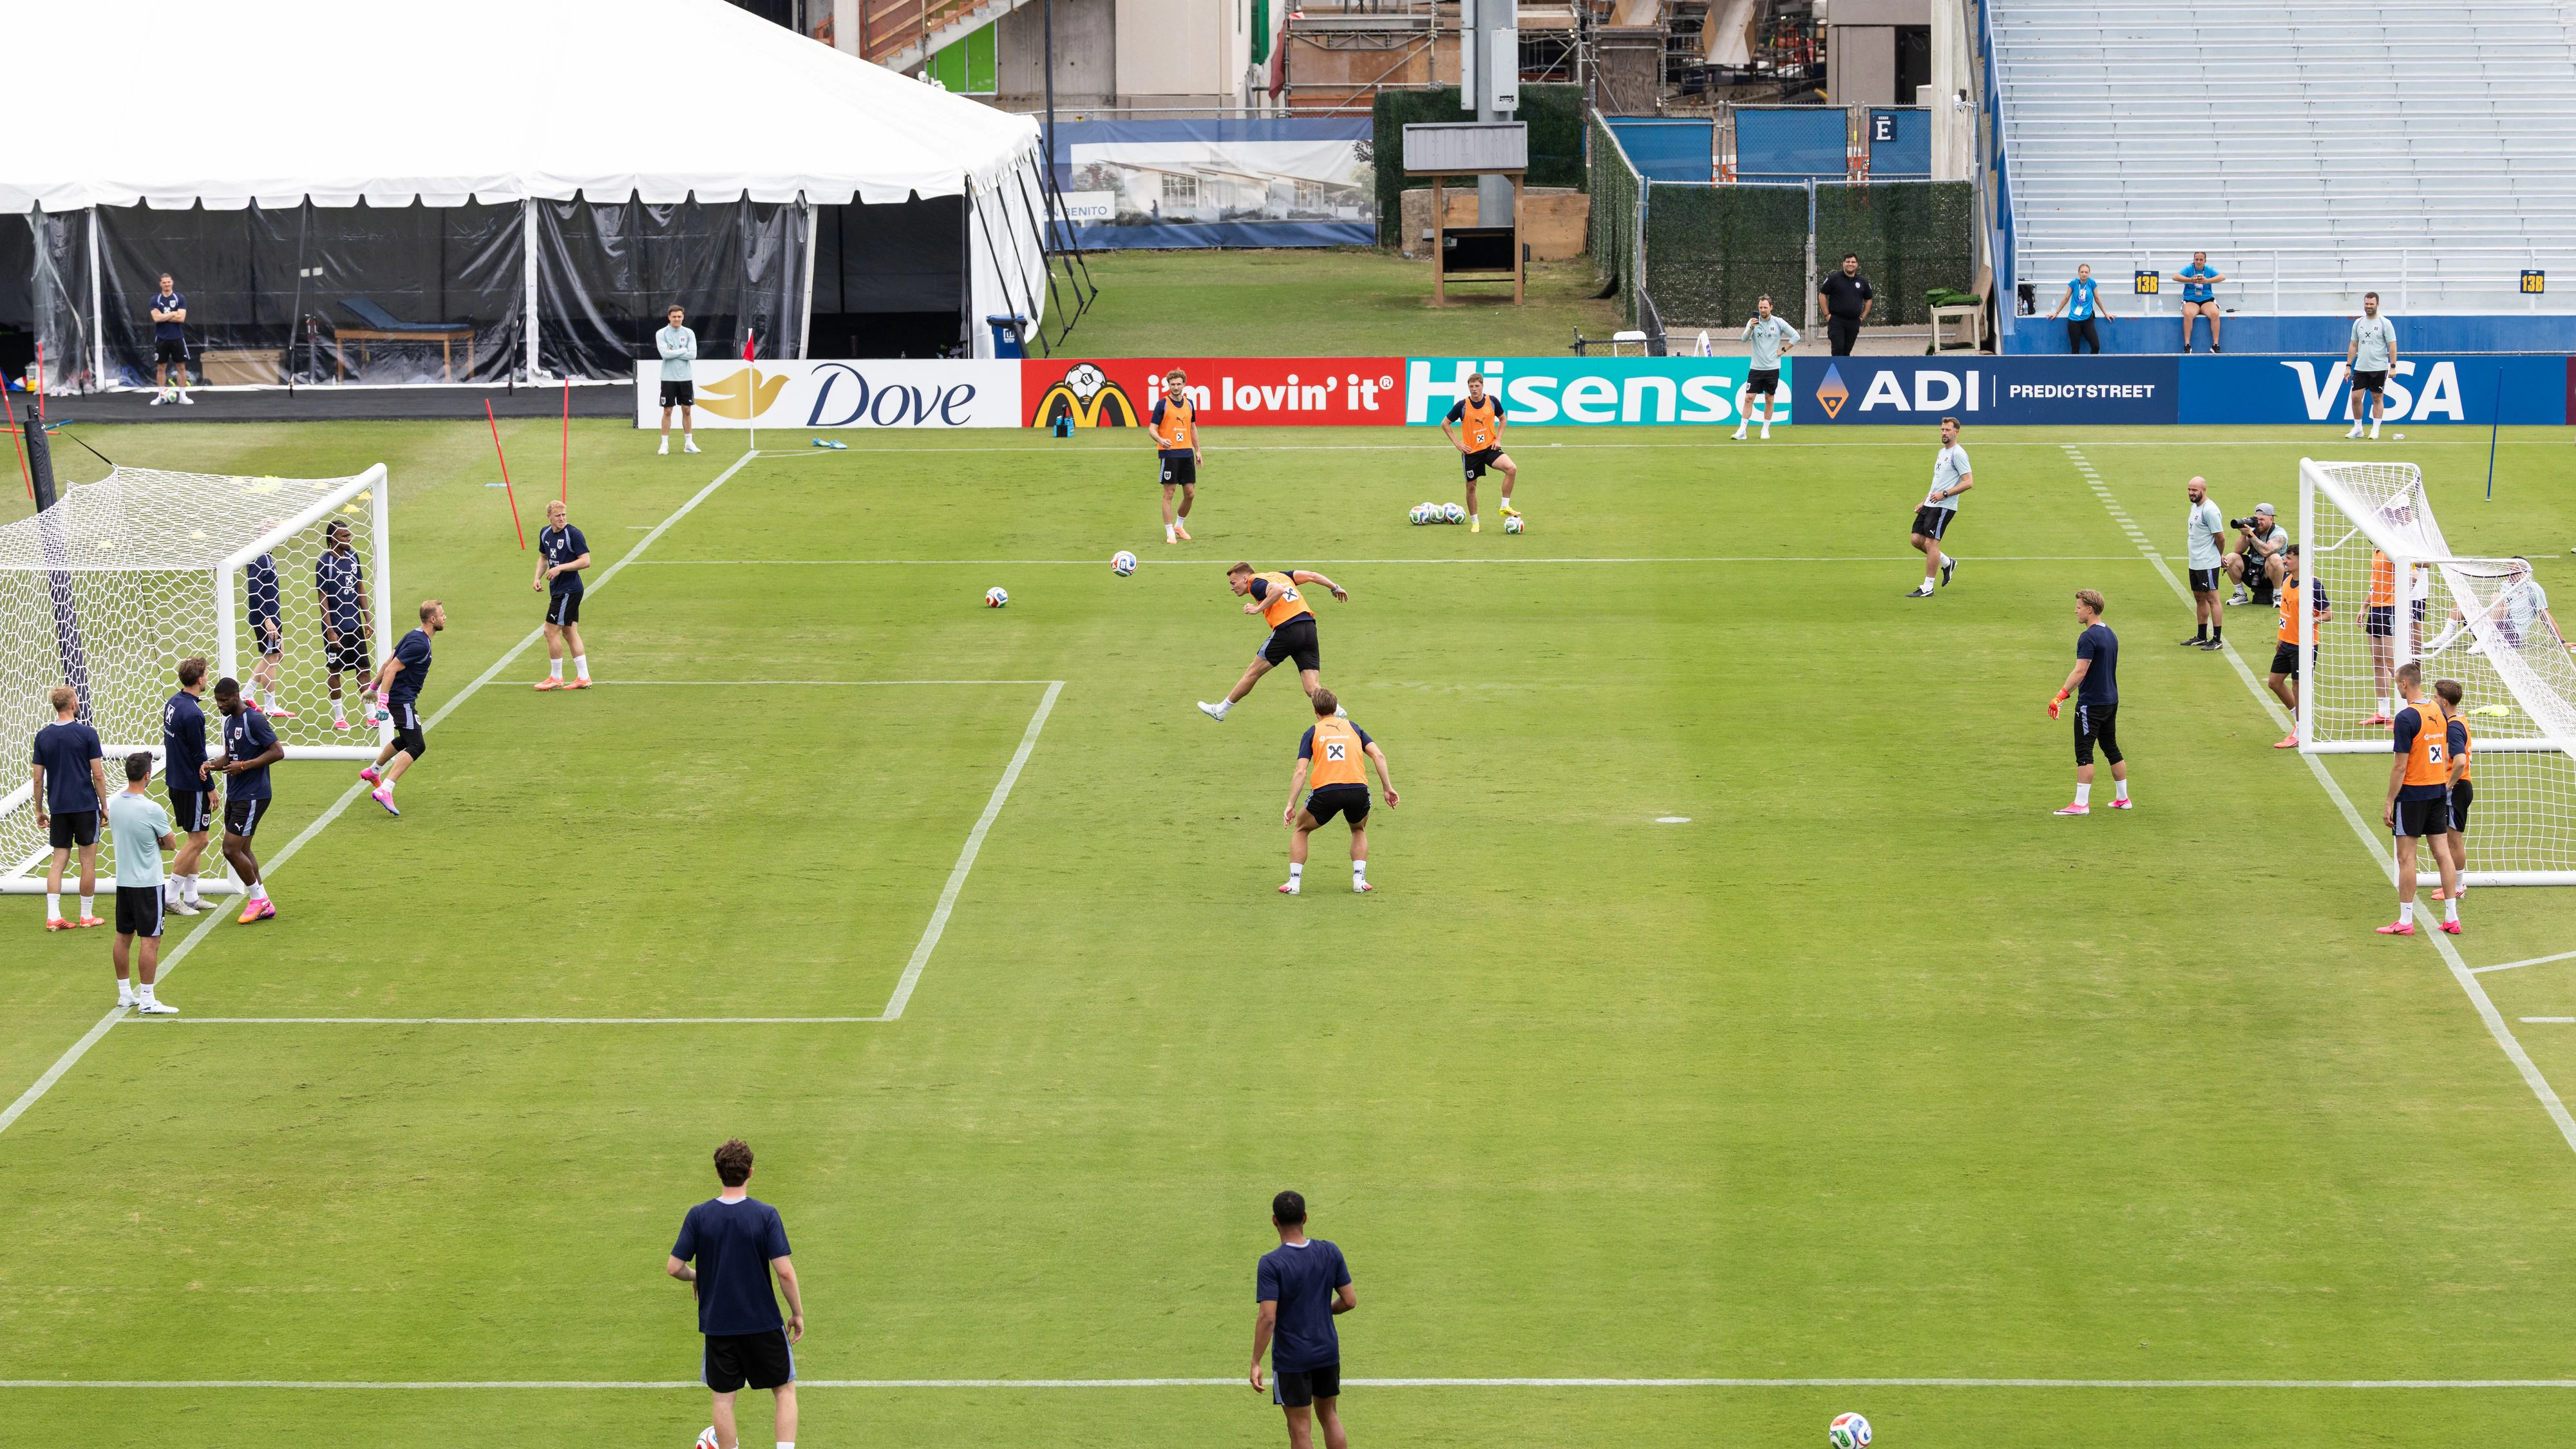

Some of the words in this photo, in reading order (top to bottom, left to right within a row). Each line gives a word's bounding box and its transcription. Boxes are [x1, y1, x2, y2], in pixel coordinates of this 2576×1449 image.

[1876, 120, 1891, 140] E
[2136, 276, 2158, 293] 13B
[2522, 275, 2544, 292] 13B
[806, 363, 976, 426] Dove
[1222, 374, 1338, 411] lovin'
[1859, 370, 1979, 411] ADI
[2010, 384, 2155, 398] PREDICTSTREET
